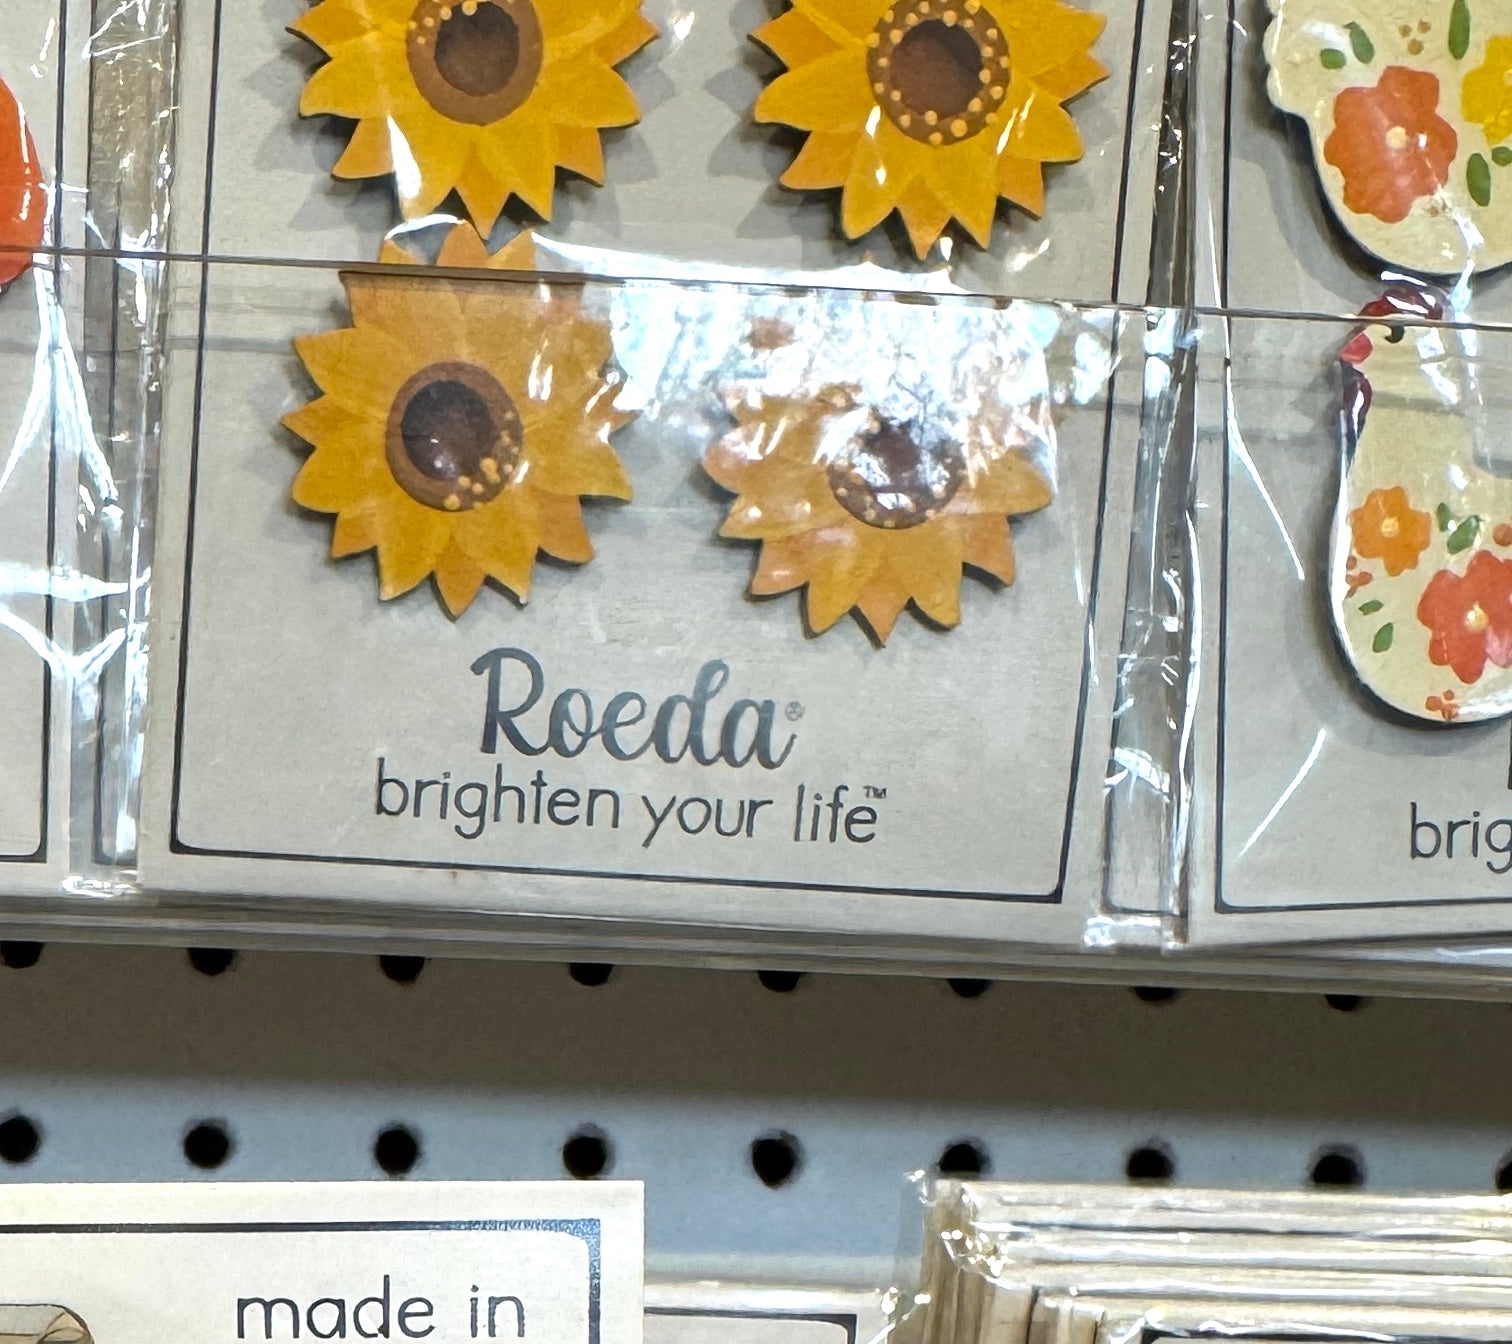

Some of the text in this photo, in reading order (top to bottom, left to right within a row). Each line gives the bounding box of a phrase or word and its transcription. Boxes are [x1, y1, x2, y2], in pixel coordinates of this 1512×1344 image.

[374, 757, 622, 839] brighten
[641, 795, 774, 848] your
[237, 1275, 526, 1339] made in
